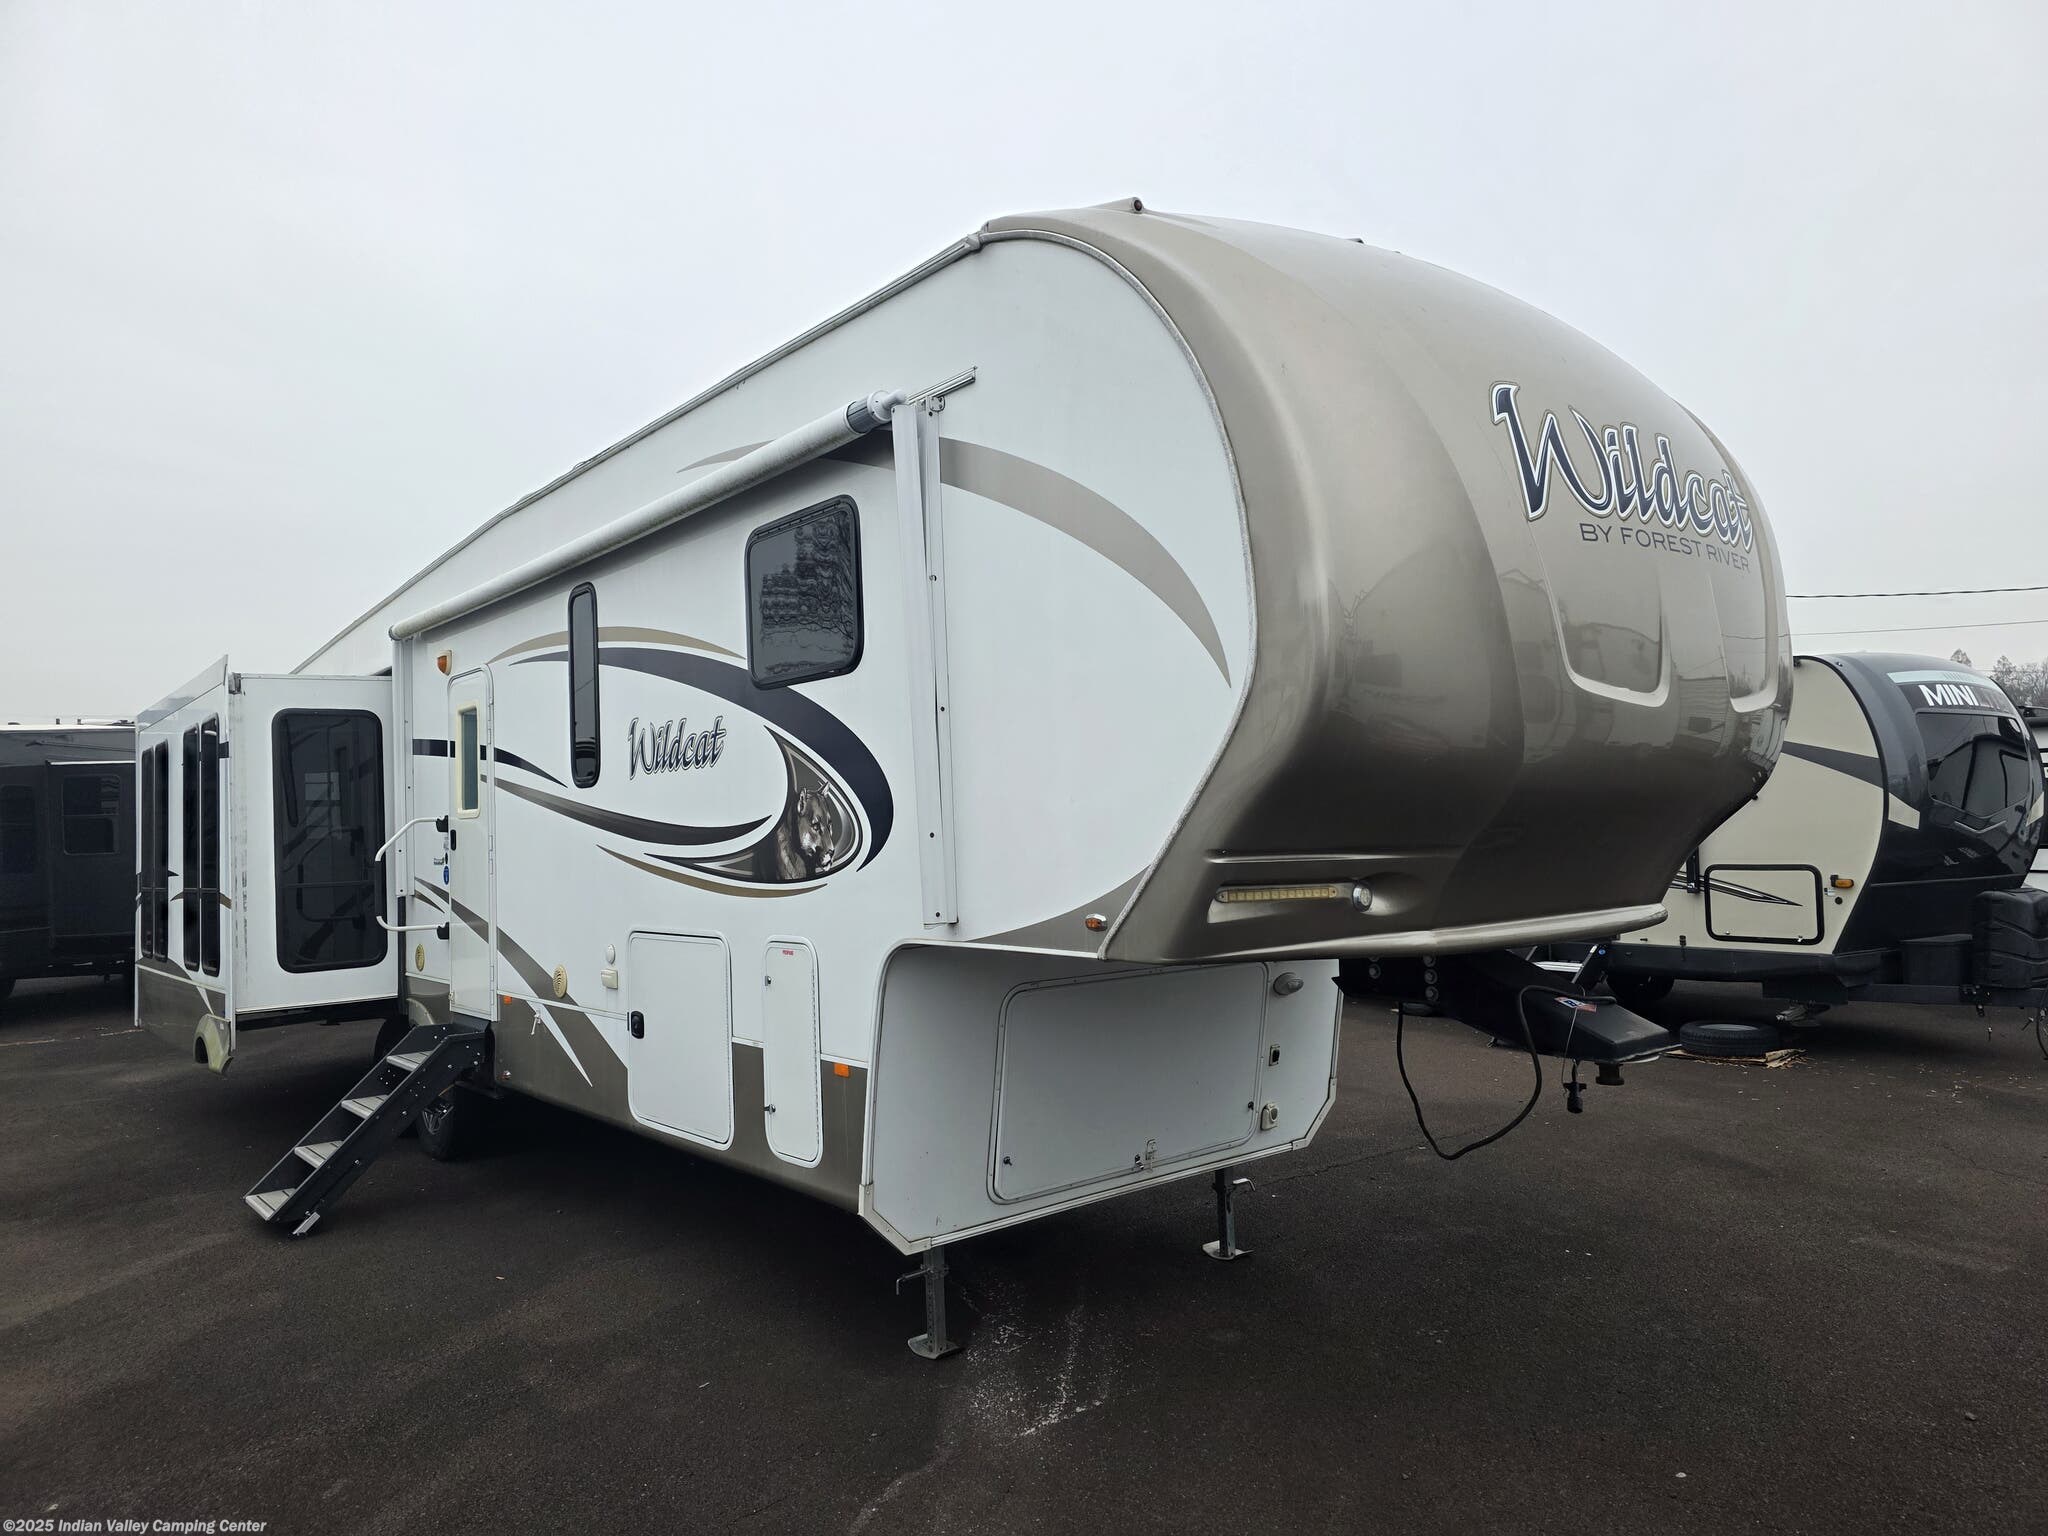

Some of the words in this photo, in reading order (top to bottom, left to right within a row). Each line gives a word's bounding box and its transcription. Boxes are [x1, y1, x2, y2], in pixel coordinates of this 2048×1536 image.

[1489, 382, 1753, 552] Wildcat
[1580, 523, 1612, 543] BY
[1621, 527, 1702, 558] FOREST
[1706, 544, 1751, 572] RIVER
[1918, 684, 1979, 706] MINI
[628, 715, 727, 780] Wildcat
